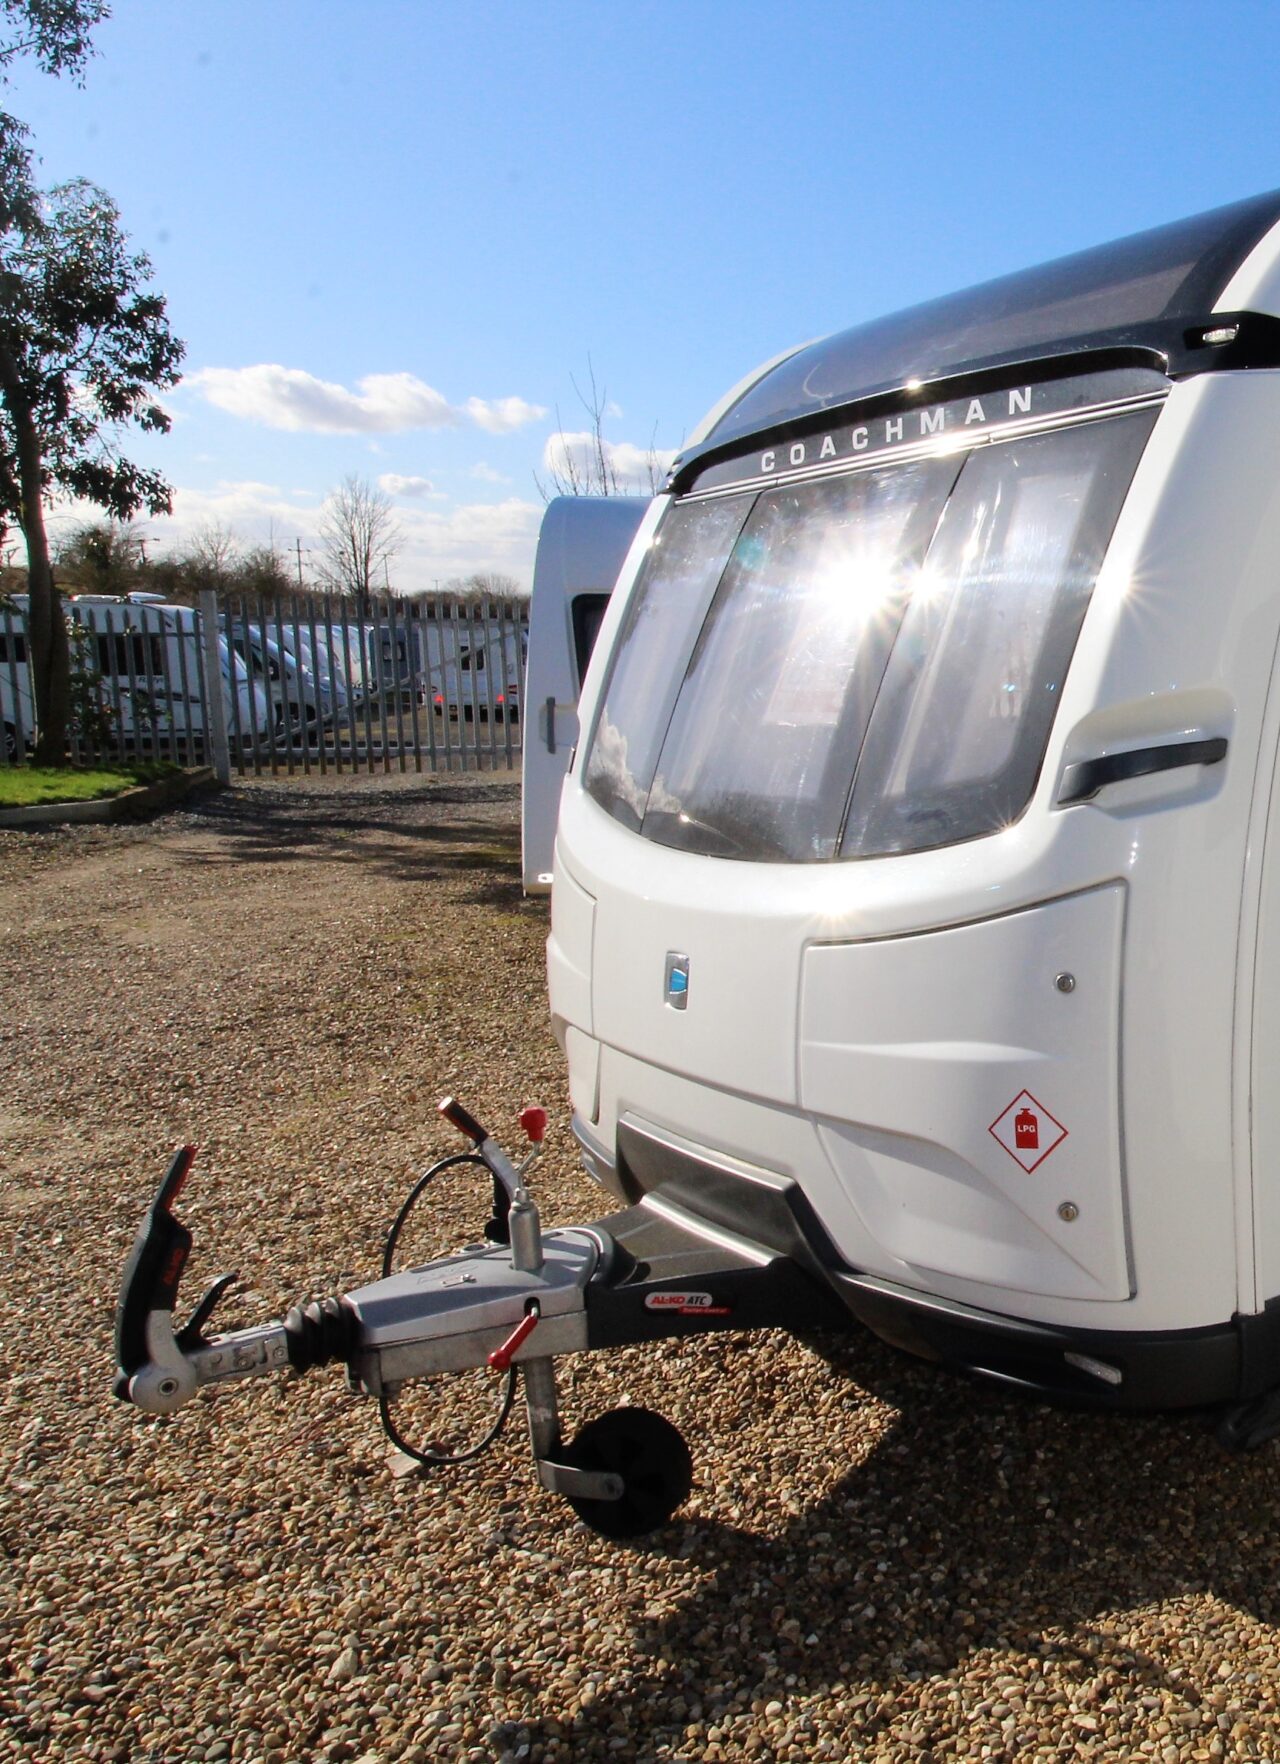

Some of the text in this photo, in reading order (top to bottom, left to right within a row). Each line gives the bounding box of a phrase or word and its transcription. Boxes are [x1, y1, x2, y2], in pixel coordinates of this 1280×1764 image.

[760, 386, 1032, 473] COACHMAN
[1017, 1124, 1036, 1133] LPG
[686, 1296, 708, 1305] ATC
